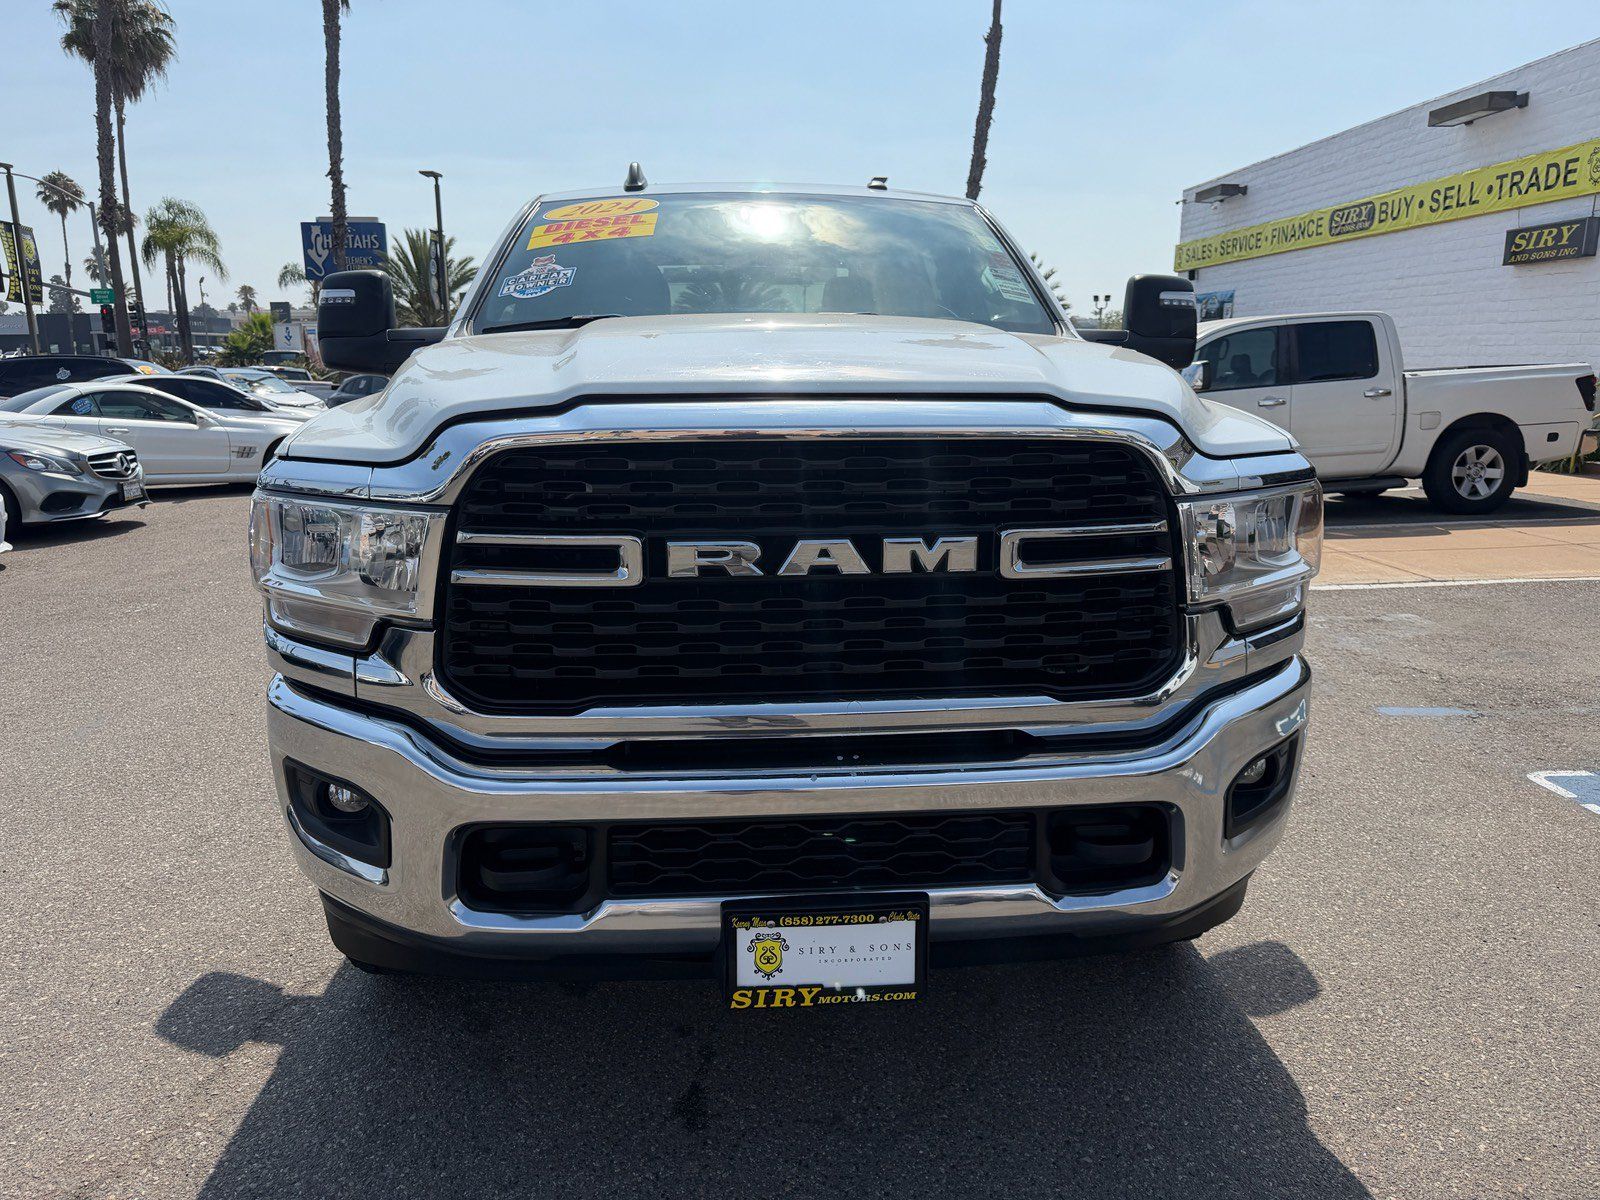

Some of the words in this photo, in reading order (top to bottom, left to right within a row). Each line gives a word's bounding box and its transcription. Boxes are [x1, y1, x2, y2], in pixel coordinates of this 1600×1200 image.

[561, 200, 642, 218] 2024
[1186, 245, 1212, 263] SALES
[1219, 232, 1262, 256] SERVICE
[1270, 217, 1324, 246] FINANCE
[1333, 204, 1373, 225] SIRY
[1378, 195, 1415, 223] BUY
[1429, 181, 1480, 213] SELL
[1496, 157, 1580, 200] TRADE
[543, 214, 647, 234] DIESEL
[1511, 224, 1580, 253] SIRY
[1508, 253, 1529, 263] AND
[1530, 250, 1557, 261] SONS
[1558, 247, 1578, 257] INC
[508, 270, 571, 285] CARFAX
[516, 278, 567, 290] OWNER
[667, 536, 978, 578] RAM
[780, 916, 814, 926] (858)
[815, 914, 875, 925] 277-7300
[798, 946, 837, 955] SIRY
[849, 945, 856, 953] &
[869, 943, 912, 952] SONS
